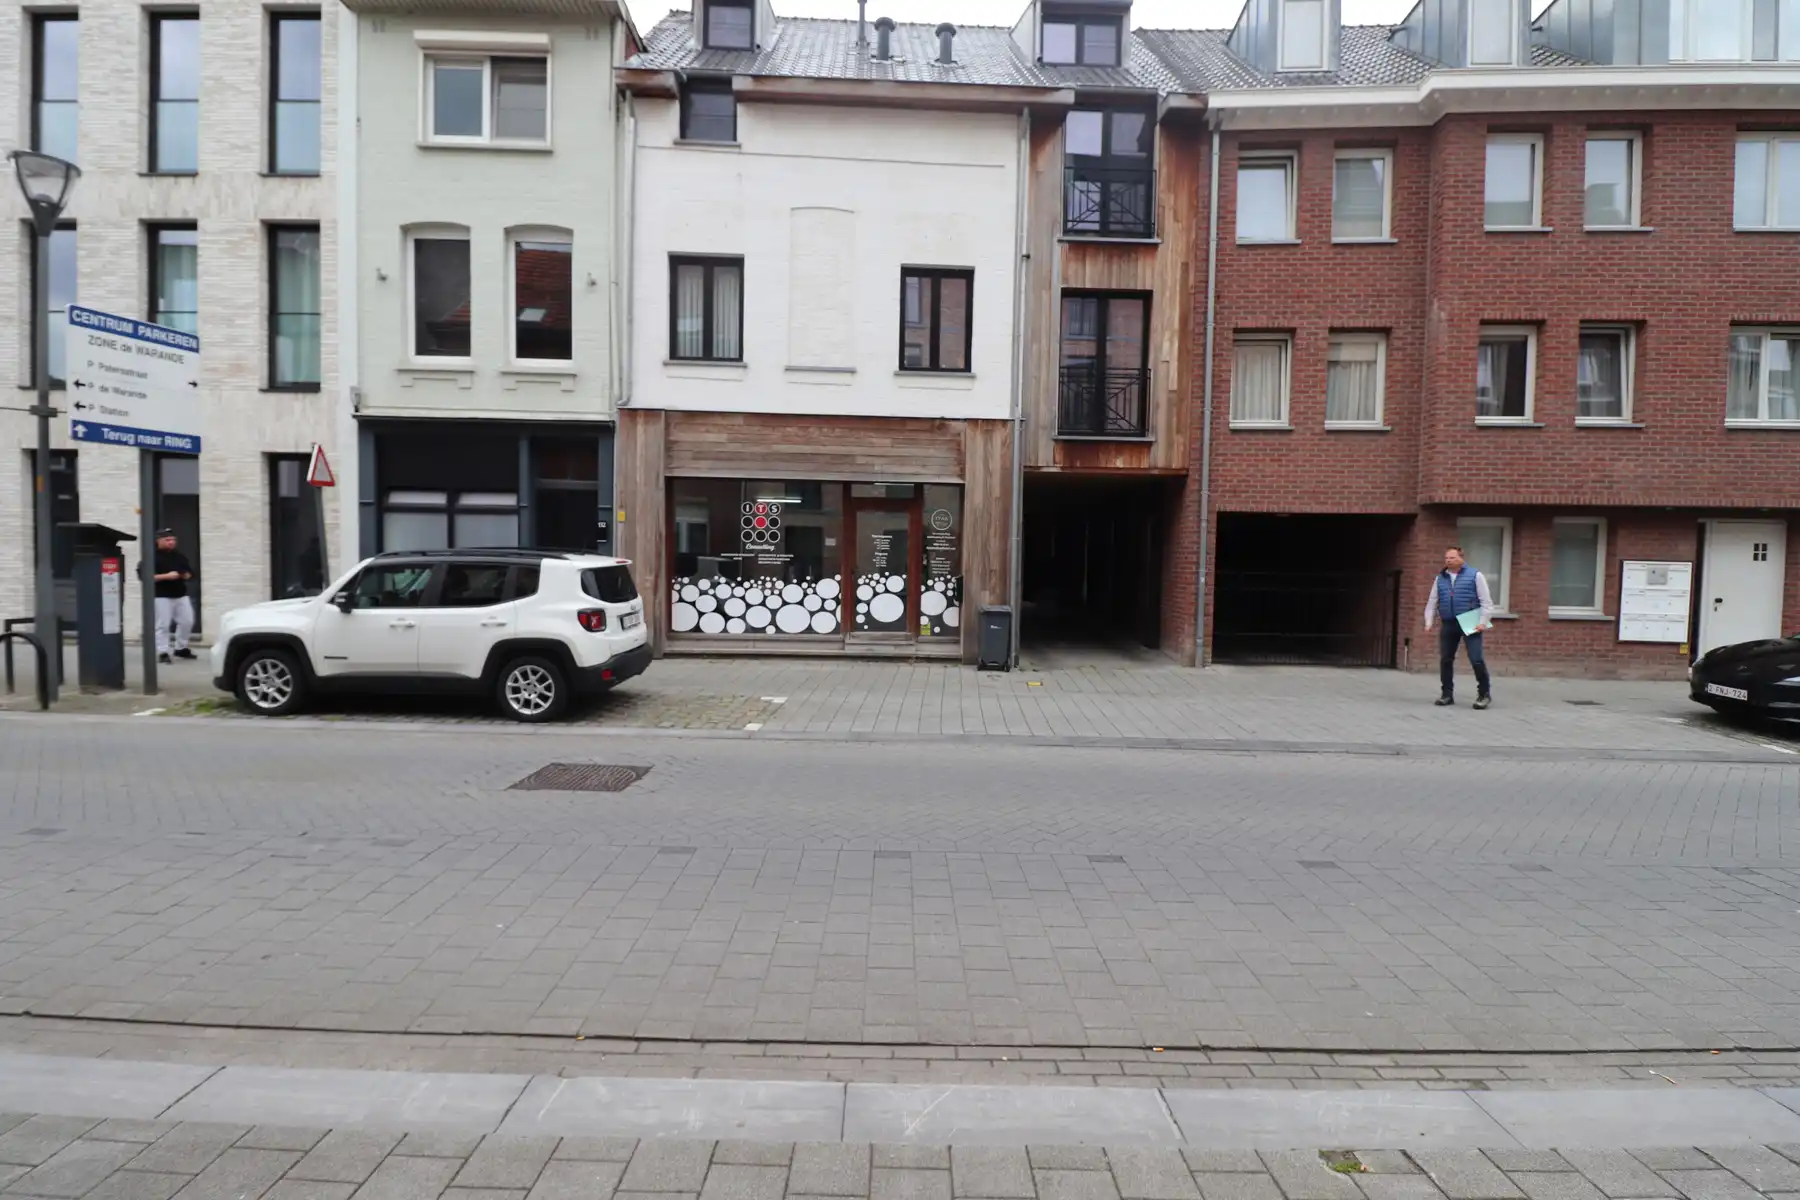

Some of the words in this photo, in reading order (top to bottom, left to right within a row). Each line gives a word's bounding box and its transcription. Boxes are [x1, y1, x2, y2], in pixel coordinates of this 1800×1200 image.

[71, 309, 133, 334] CENTRUM
[137, 325, 198, 349] PARKEREN
[87, 334, 118, 351] ZONE
[120, 343, 132, 354] de
[135, 345, 185, 365] WARANDE
[98, 384, 109, 394] de
[112, 386, 148, 400] Warande
[99, 405, 129, 417] Station
[101, 428, 135, 446] Terug
[137, 433, 162, 446] naar
[164, 435, 193, 450] RING
